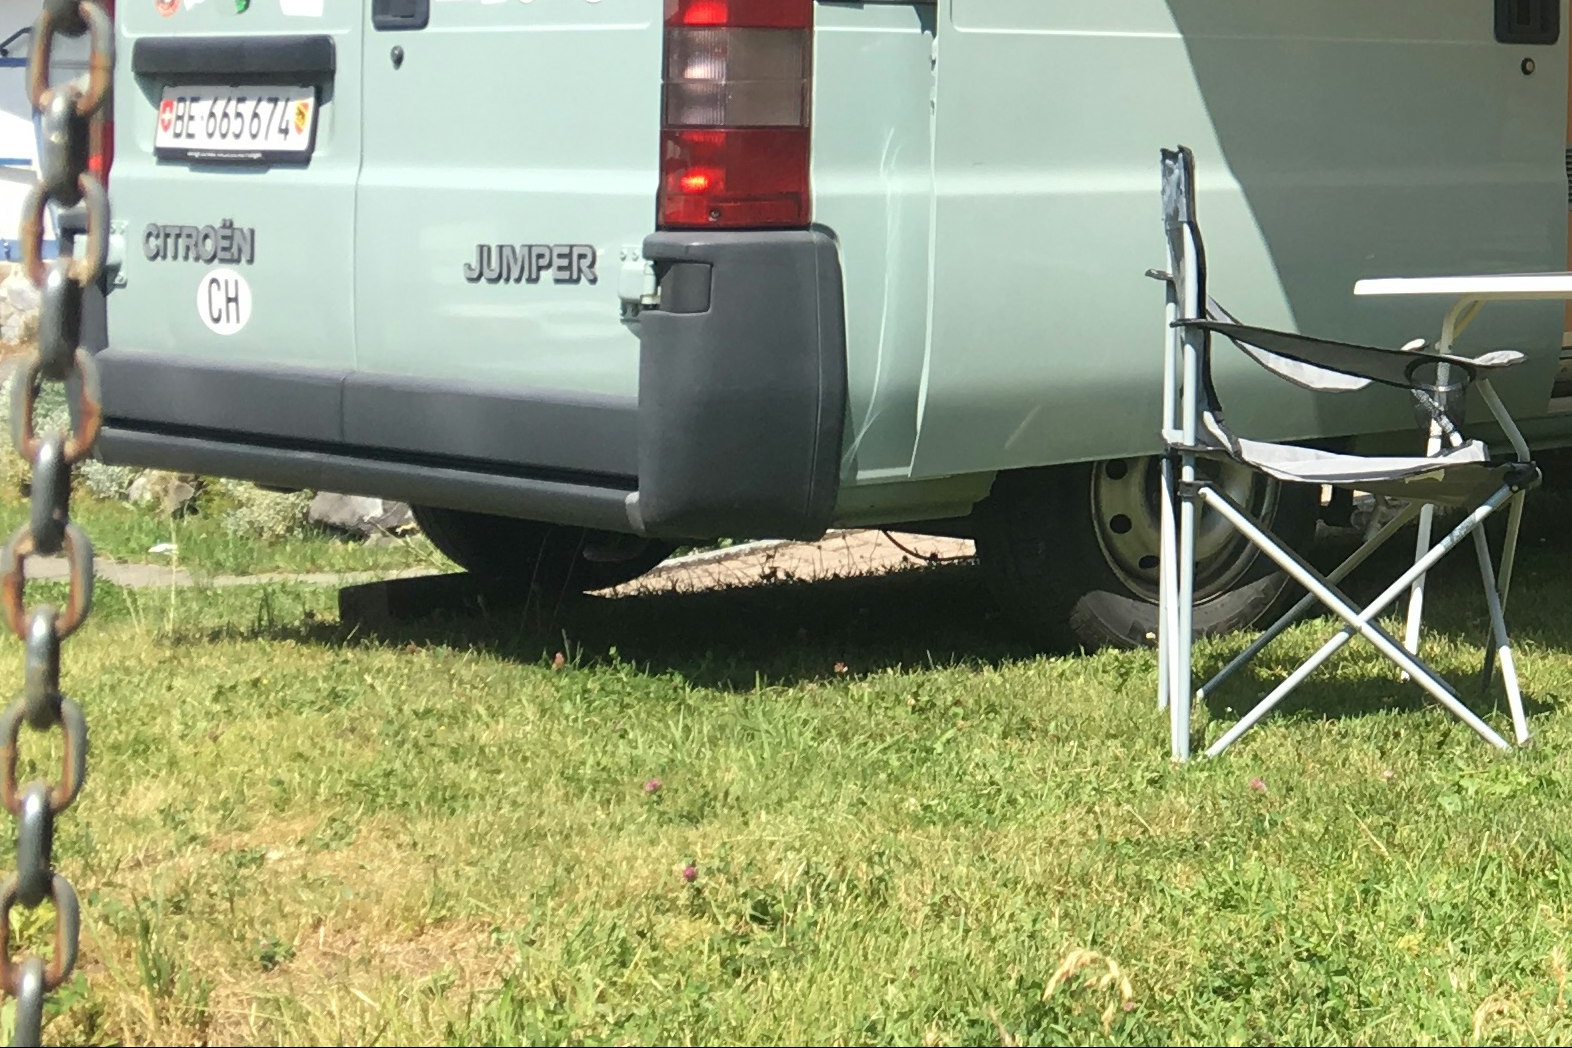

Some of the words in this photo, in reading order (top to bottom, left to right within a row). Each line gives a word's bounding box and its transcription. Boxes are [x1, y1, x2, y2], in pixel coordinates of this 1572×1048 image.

[143, 218, 255, 265] CITROËN
[463, 244, 598, 285] JUMPER
[207, 277, 240, 324] CH
